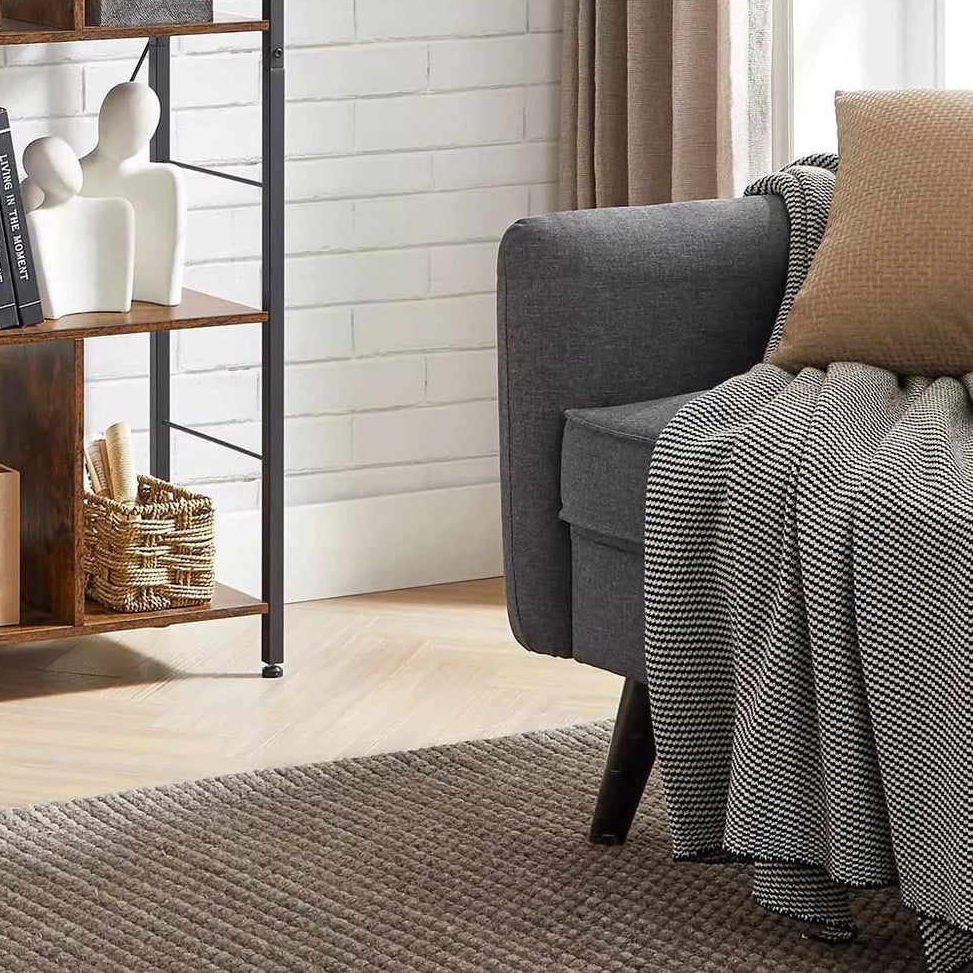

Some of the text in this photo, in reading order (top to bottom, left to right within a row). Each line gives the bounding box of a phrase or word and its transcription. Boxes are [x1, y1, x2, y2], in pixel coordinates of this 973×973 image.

[0, 154, 29, 280] LIVING IN THE MOMENT
